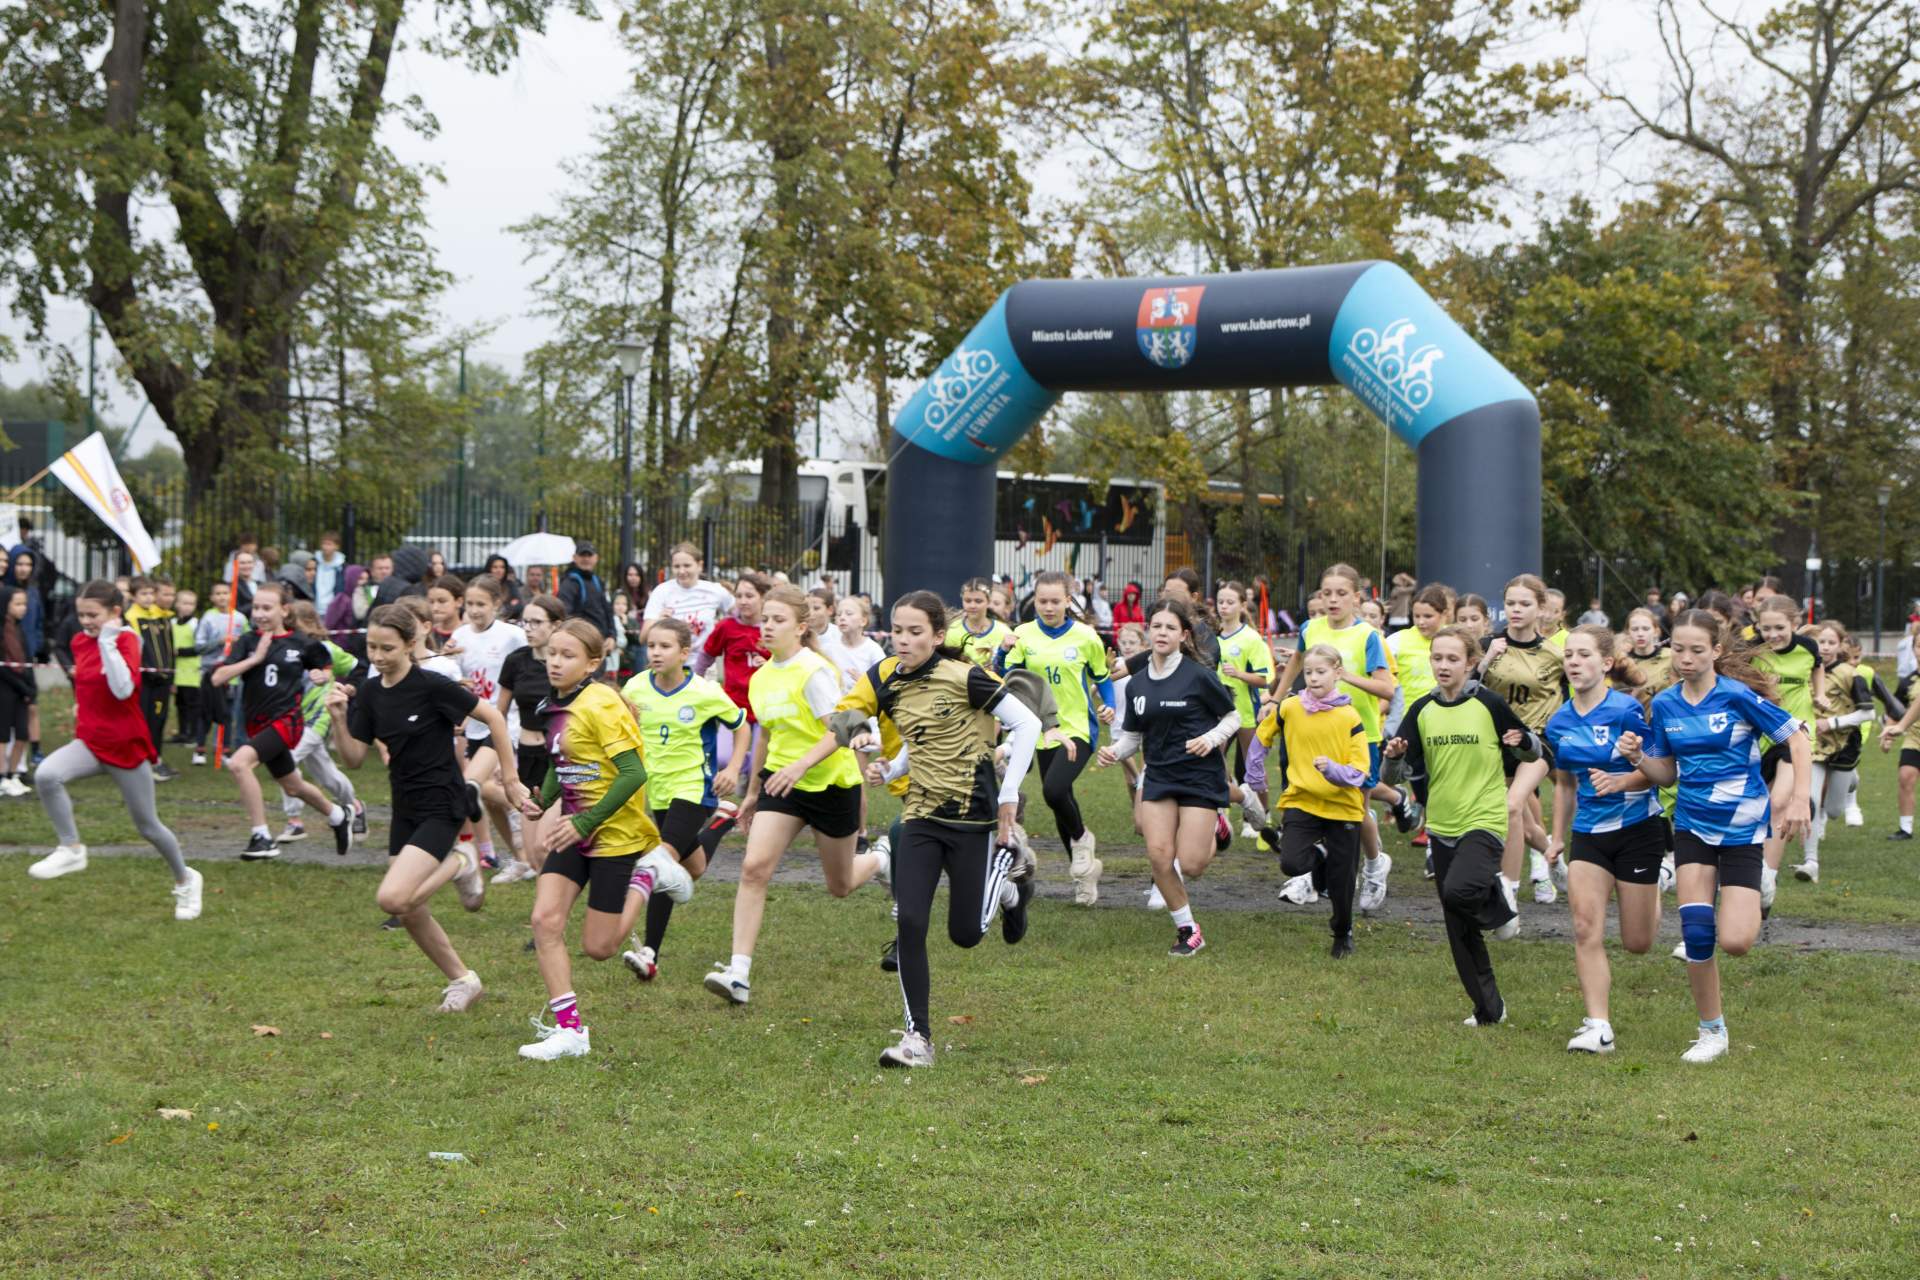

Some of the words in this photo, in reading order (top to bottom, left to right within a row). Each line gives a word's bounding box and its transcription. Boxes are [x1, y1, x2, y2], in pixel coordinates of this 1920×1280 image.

[1221, 314, 1311, 333] www.lubartow.pl
[1032, 330, 1065, 341] Miasto
[1066, 328, 1113, 340] Lubartów
[265, 664, 279, 687] 6
[1045, 666, 1061, 685] 16
[1508, 683, 1530, 705] 10
[1133, 696, 1146, 715] 10
[660, 724, 669, 745] 9
[1432, 735, 1449, 747] WOLA
[1450, 734, 1479, 745] SERNICKA
